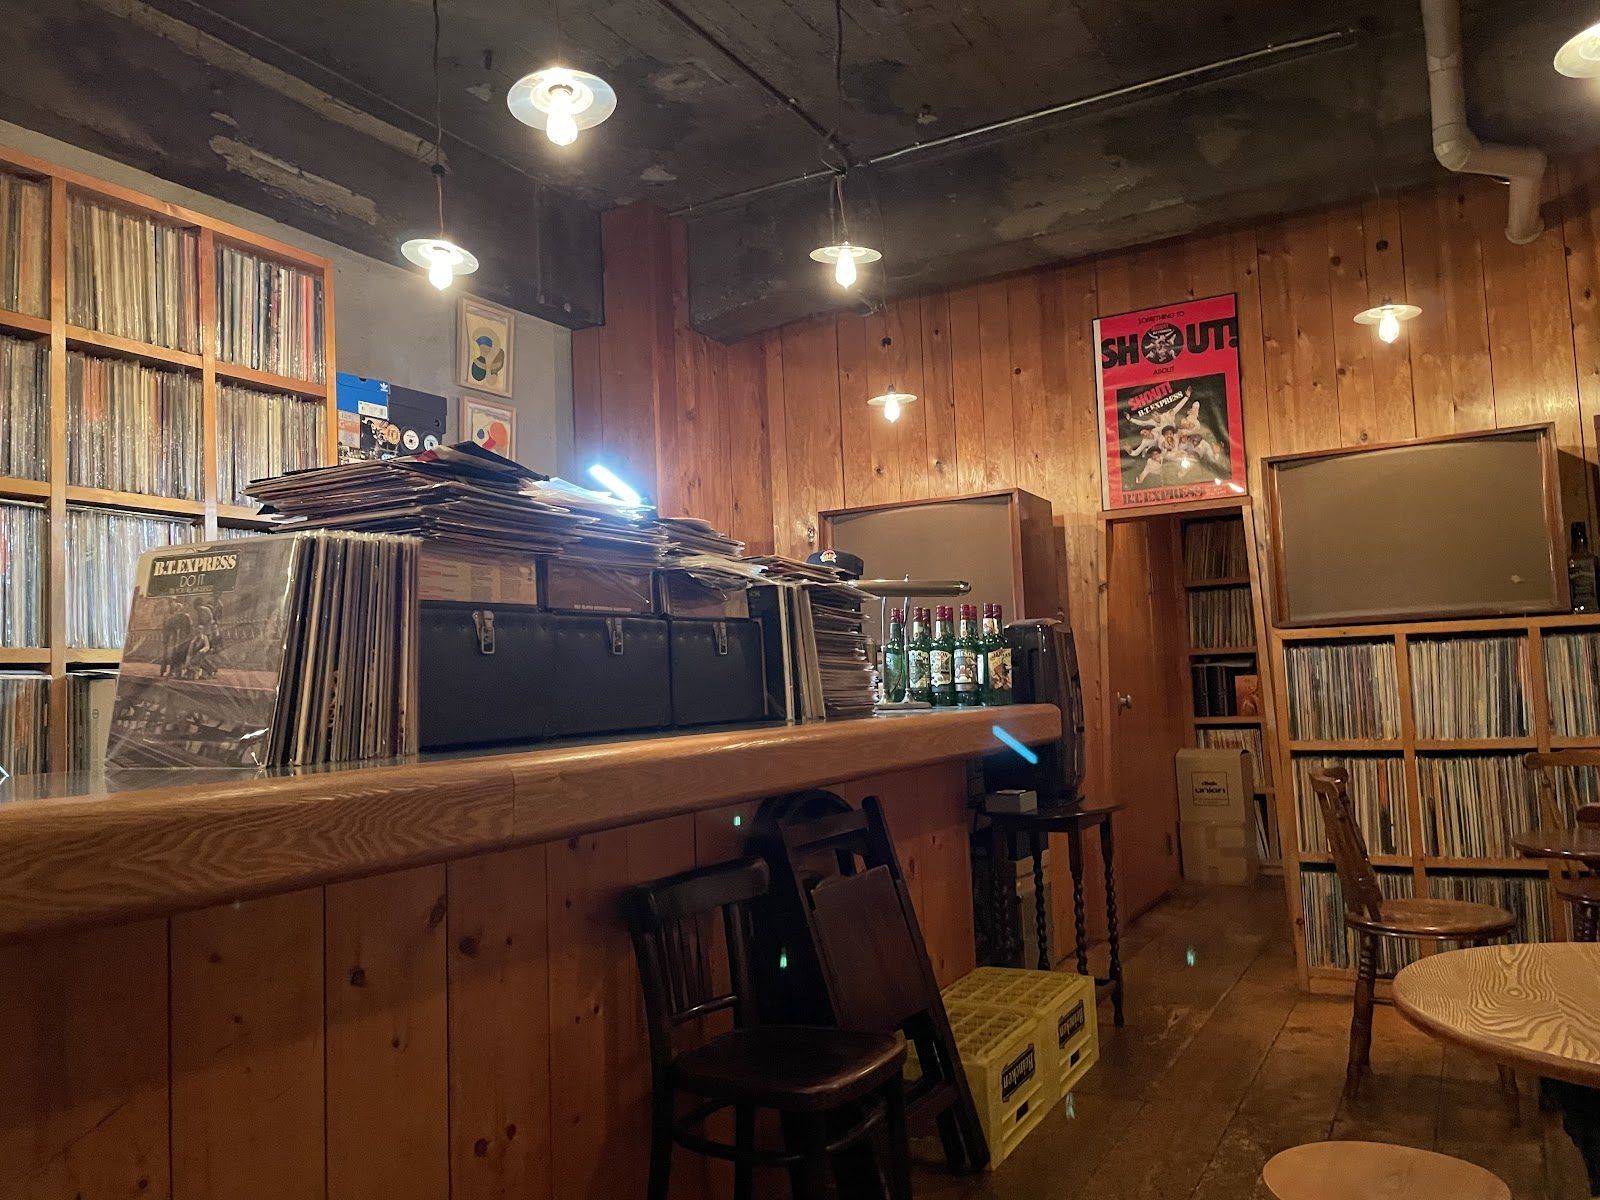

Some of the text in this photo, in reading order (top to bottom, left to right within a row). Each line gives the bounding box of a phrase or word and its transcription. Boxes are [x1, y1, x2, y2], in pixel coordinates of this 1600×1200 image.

[1138, 314, 1174, 324] SOMETHING
[1153, 366, 1174, 375] ABOUT
[180, 574, 206, 588] DO IT
